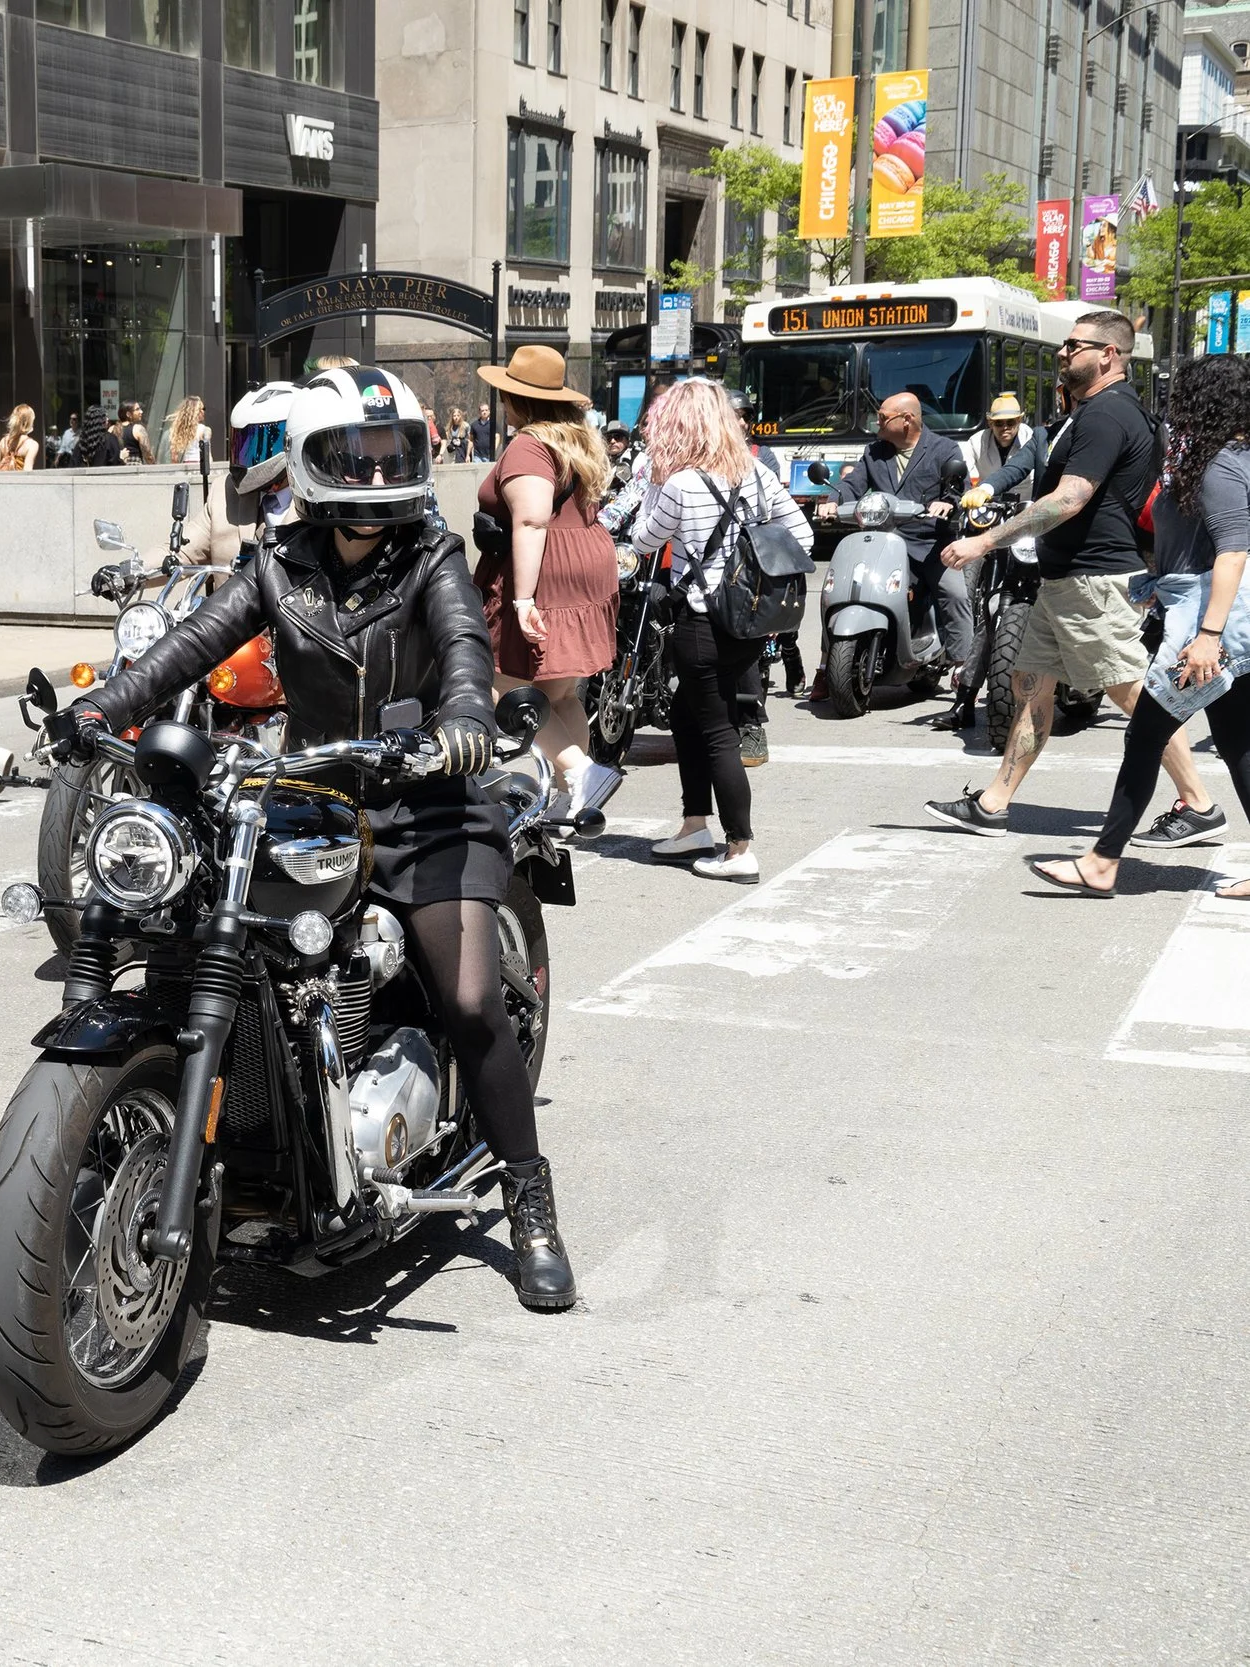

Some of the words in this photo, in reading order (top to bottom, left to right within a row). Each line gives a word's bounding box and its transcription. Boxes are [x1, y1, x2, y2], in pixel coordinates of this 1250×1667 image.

[813, 100, 846, 113] GLAD
[286, 113, 335, 160] VANS
[813, 118, 849, 136] HERE!
[818, 140, 839, 220] CHICAGO
[878, 214, 915, 225] CHICAGO
[1042, 213, 1064, 223] GLAD
[1043, 225, 1067, 236] HERE!
[1047, 239, 1060, 290] CHICAGO
[304, 285, 328, 303] TO
[339, 277, 393, 294] NAVY
[405, 279, 447, 300] PIER
[316, 295, 340, 307] WALK
[344, 291, 366, 302] EAST
[371, 291, 396, 299] FOUR
[399, 293, 433, 304] BLOCKS
[280, 317, 292, 327] OR
[294, 311, 315, 321] TAKE
[317, 305, 333, 314] THE
[407, 301, 428, 311] PIER
[431, 304, 469, 321] TROLLEY
[782, 309, 809, 332] 151
[822, 308, 865, 329] UNION
[869, 304, 928, 326] STATION
[368, 397, 391, 408] agv
[316, 850, 358, 871] TRIUMPH
